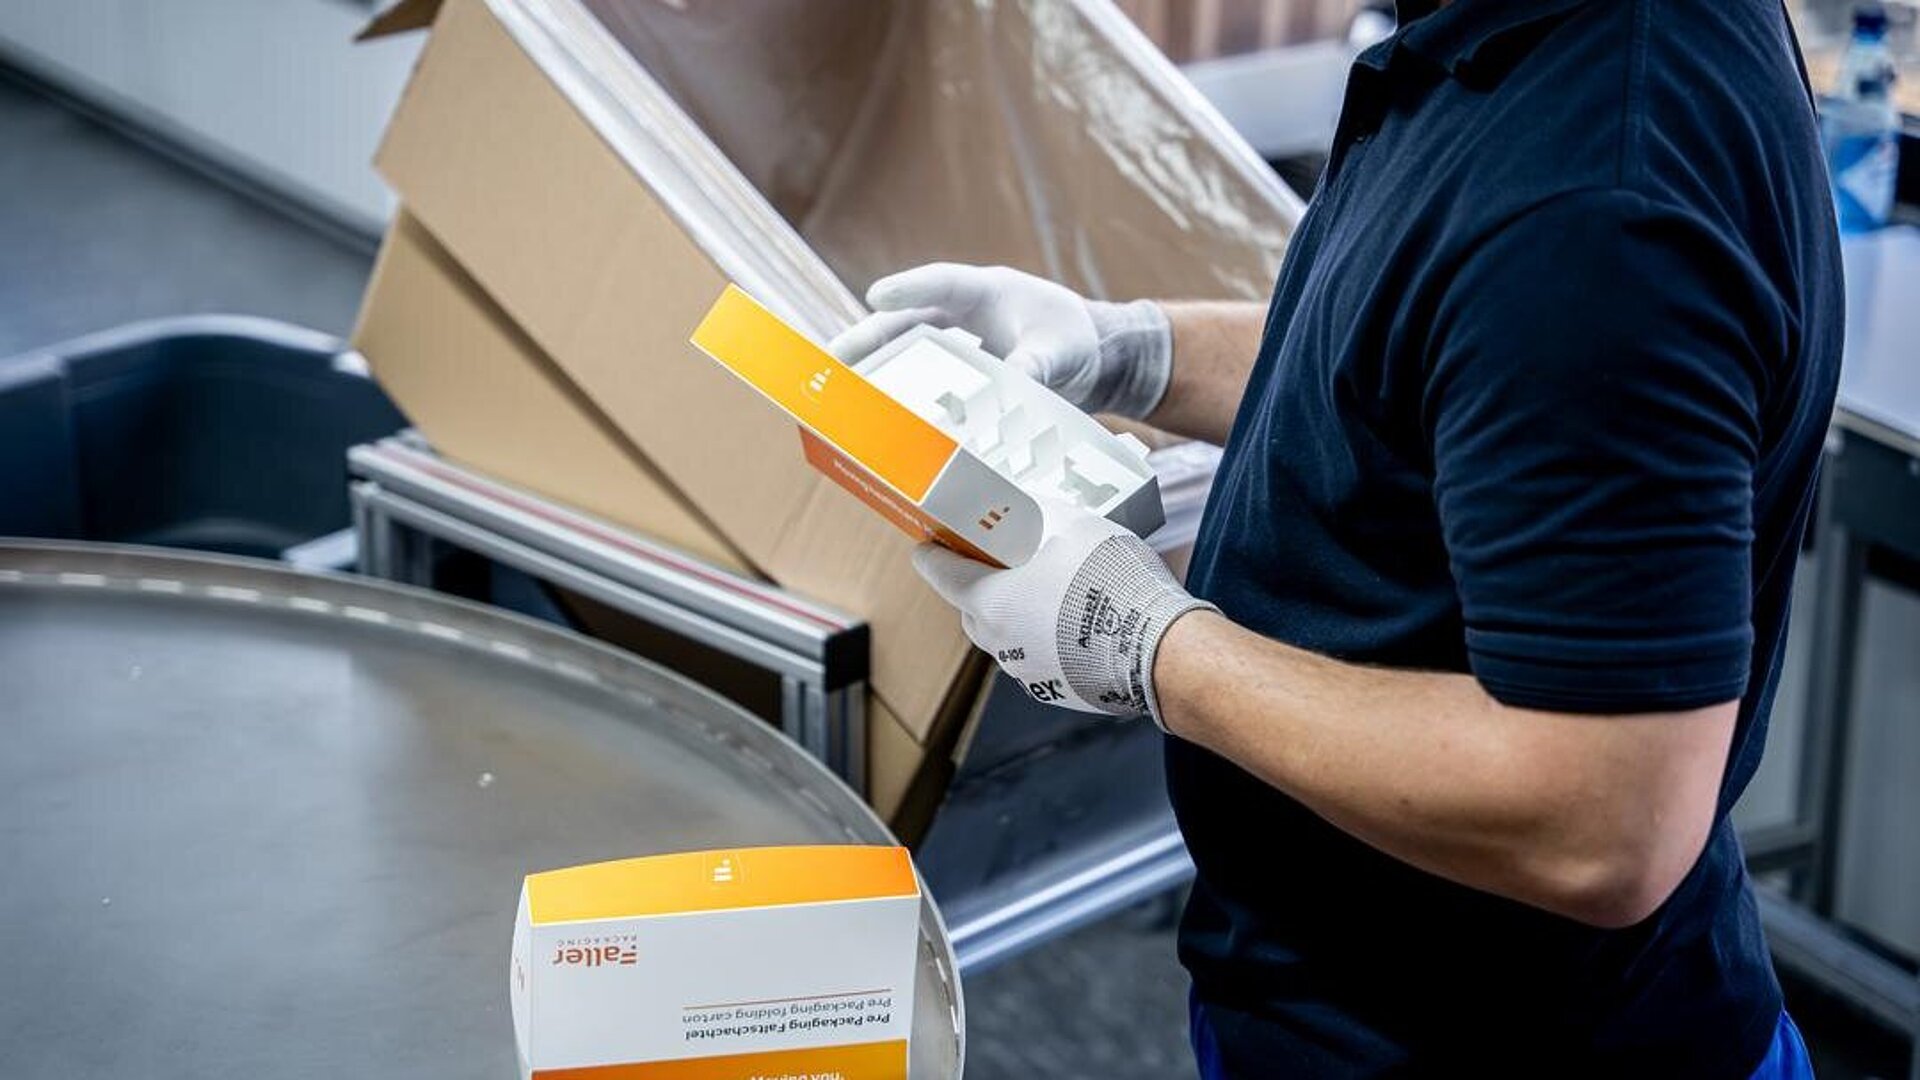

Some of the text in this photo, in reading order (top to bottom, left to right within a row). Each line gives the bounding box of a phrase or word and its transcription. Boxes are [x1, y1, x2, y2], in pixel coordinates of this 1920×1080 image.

[557, 935, 637, 947] PACKAGING
[553, 945, 637, 967] Faller
[682, 998, 891, 1023] Pre Packaging folding carton
[685, 1013, 890, 1040] Pre Packaging Faltschachtel
